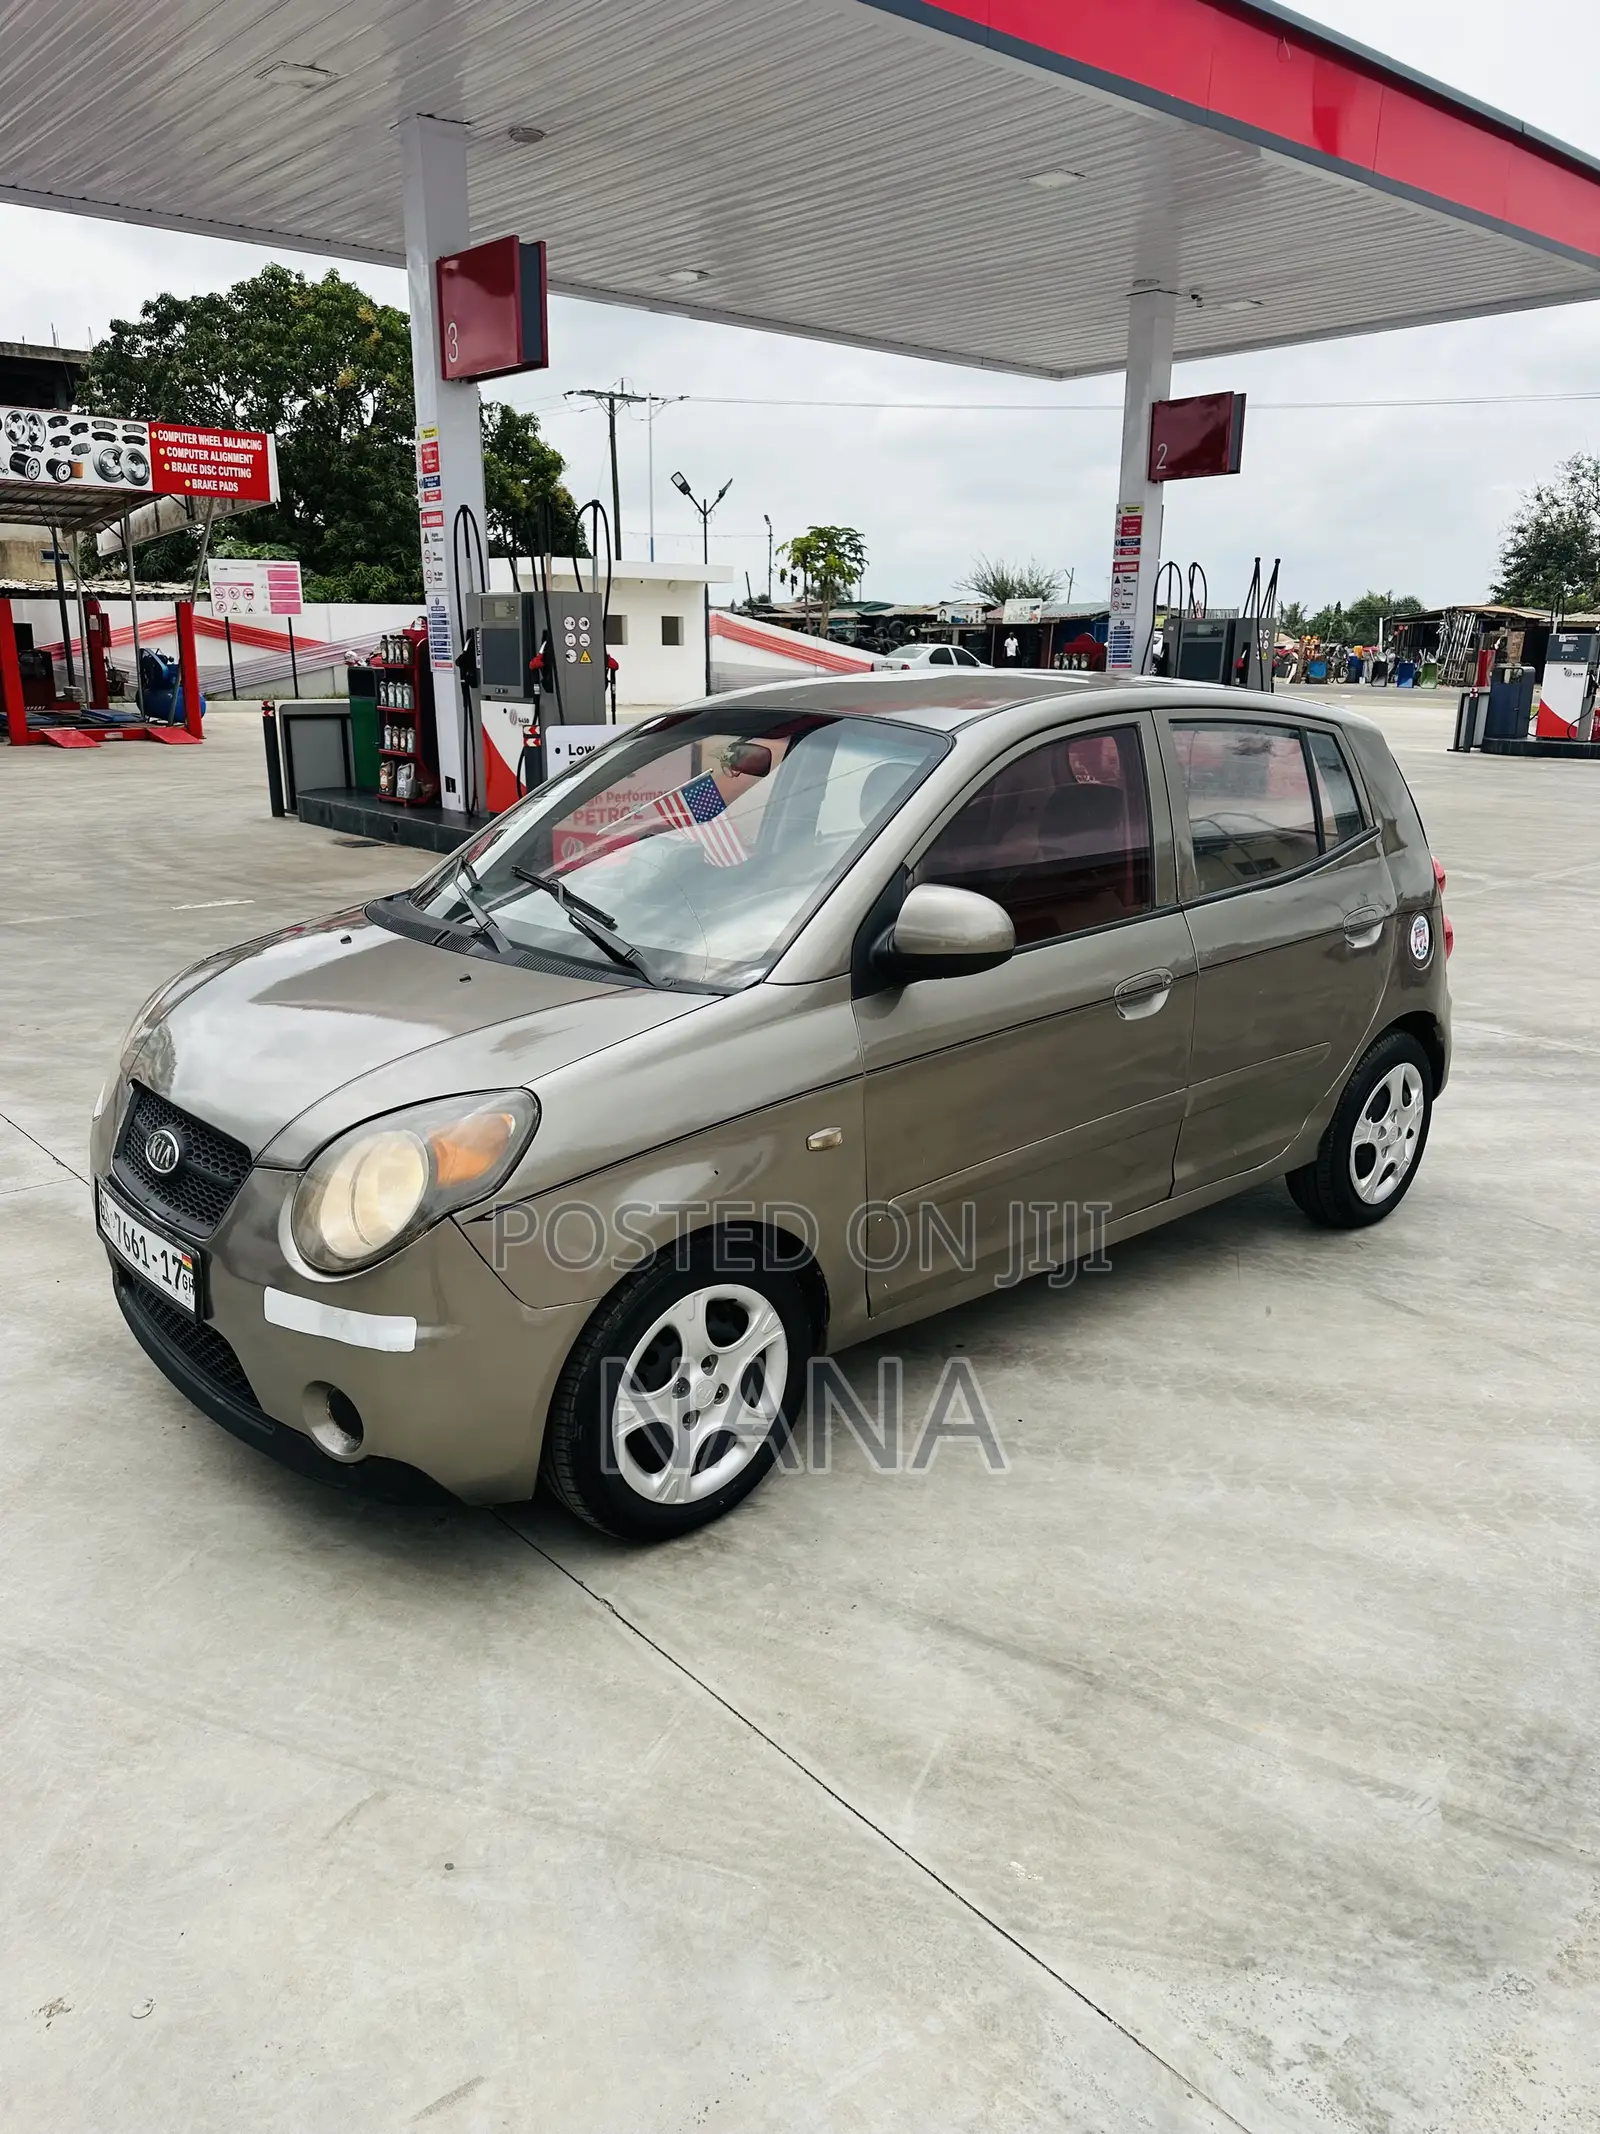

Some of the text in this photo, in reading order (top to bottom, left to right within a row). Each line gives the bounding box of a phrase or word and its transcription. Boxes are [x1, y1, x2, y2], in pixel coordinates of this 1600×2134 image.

[448, 321, 458, 363] 3
[158, 430, 262, 451] COMPUTER WHEEL BALANCING
[166, 447, 254, 464] COMPUTER ALIGNMENT
[1156, 443, 1168, 470] 2
[171, 462, 252, 478] BRAKE DISC CUTTING
[192, 479, 239, 492] BRAKE PADS
[568, 744, 596, 756] Low
